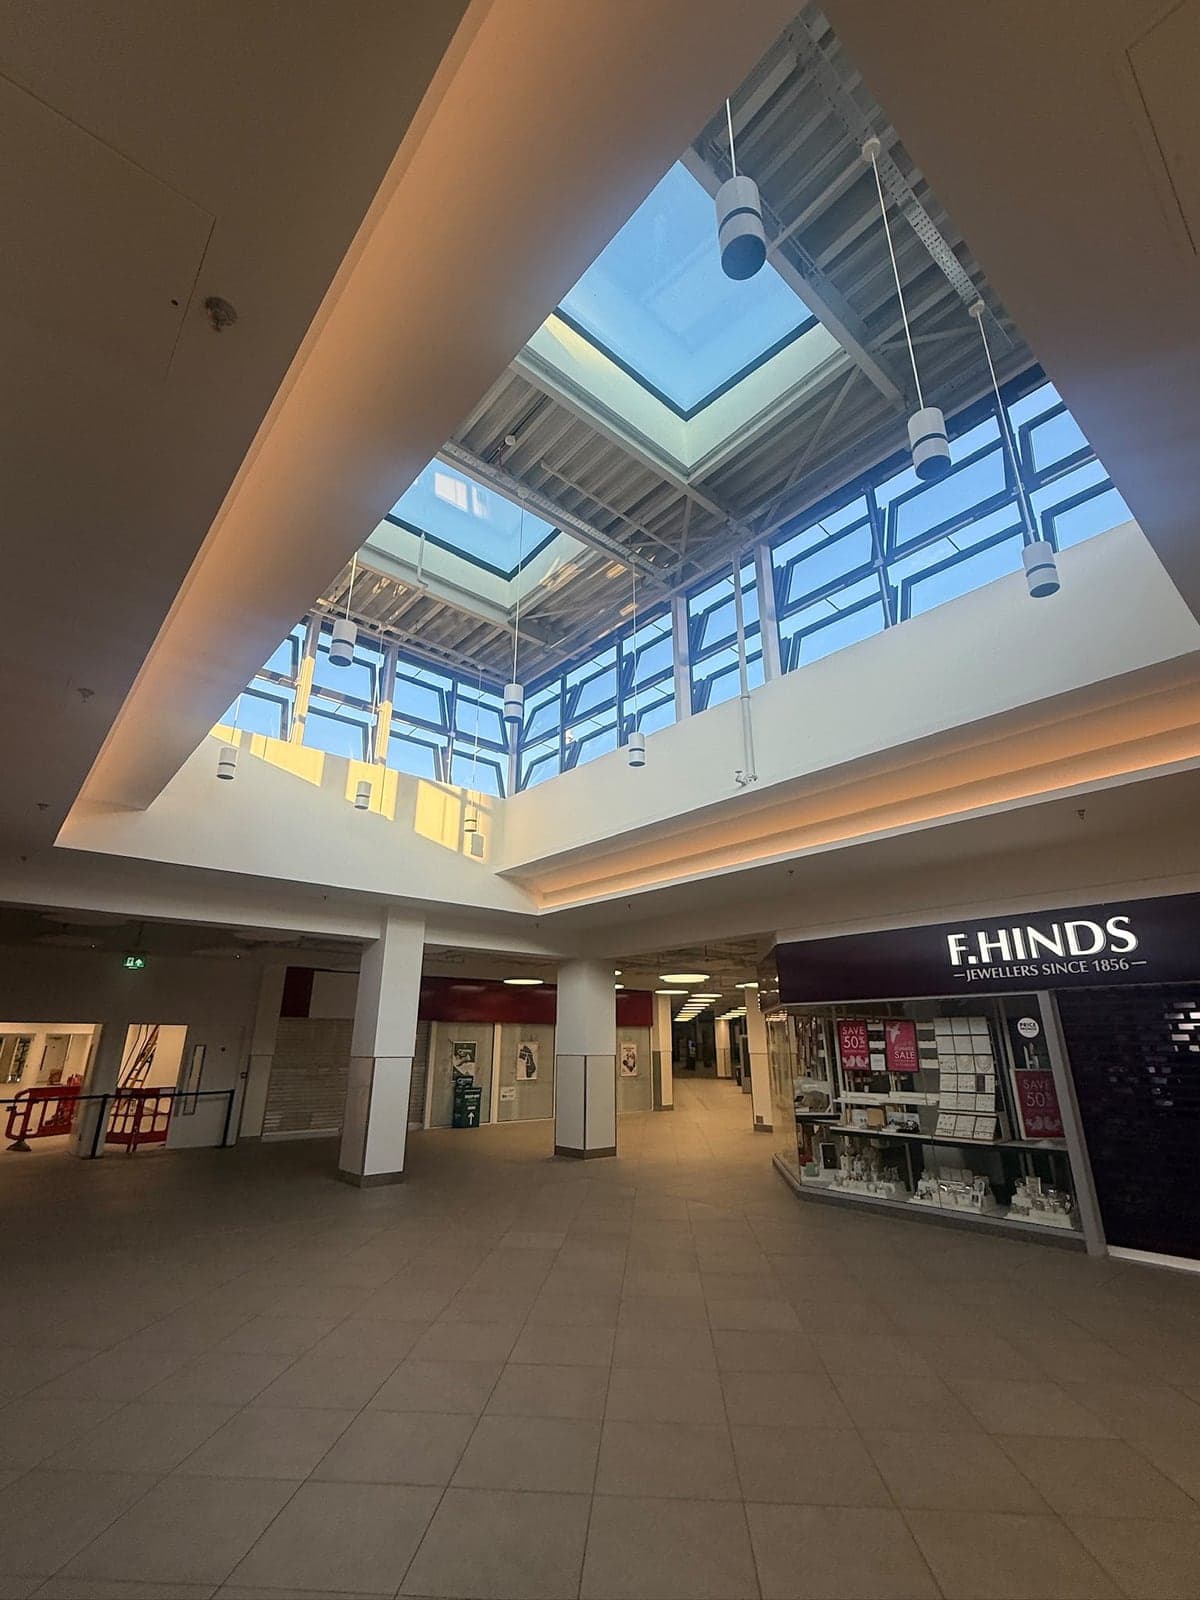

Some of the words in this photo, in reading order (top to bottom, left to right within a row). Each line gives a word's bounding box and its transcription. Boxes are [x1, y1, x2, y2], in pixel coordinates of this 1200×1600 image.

[947, 916, 1139, 966] F.HINDS
[966, 964, 1039, 983] JEWELLERS
[1042, 960, 1089, 976] SINCE
[1092, 957, 1130, 973] 1856
[842, 1026, 865, 1036] SAVE
[894, 1051, 916, 1060] SALE
